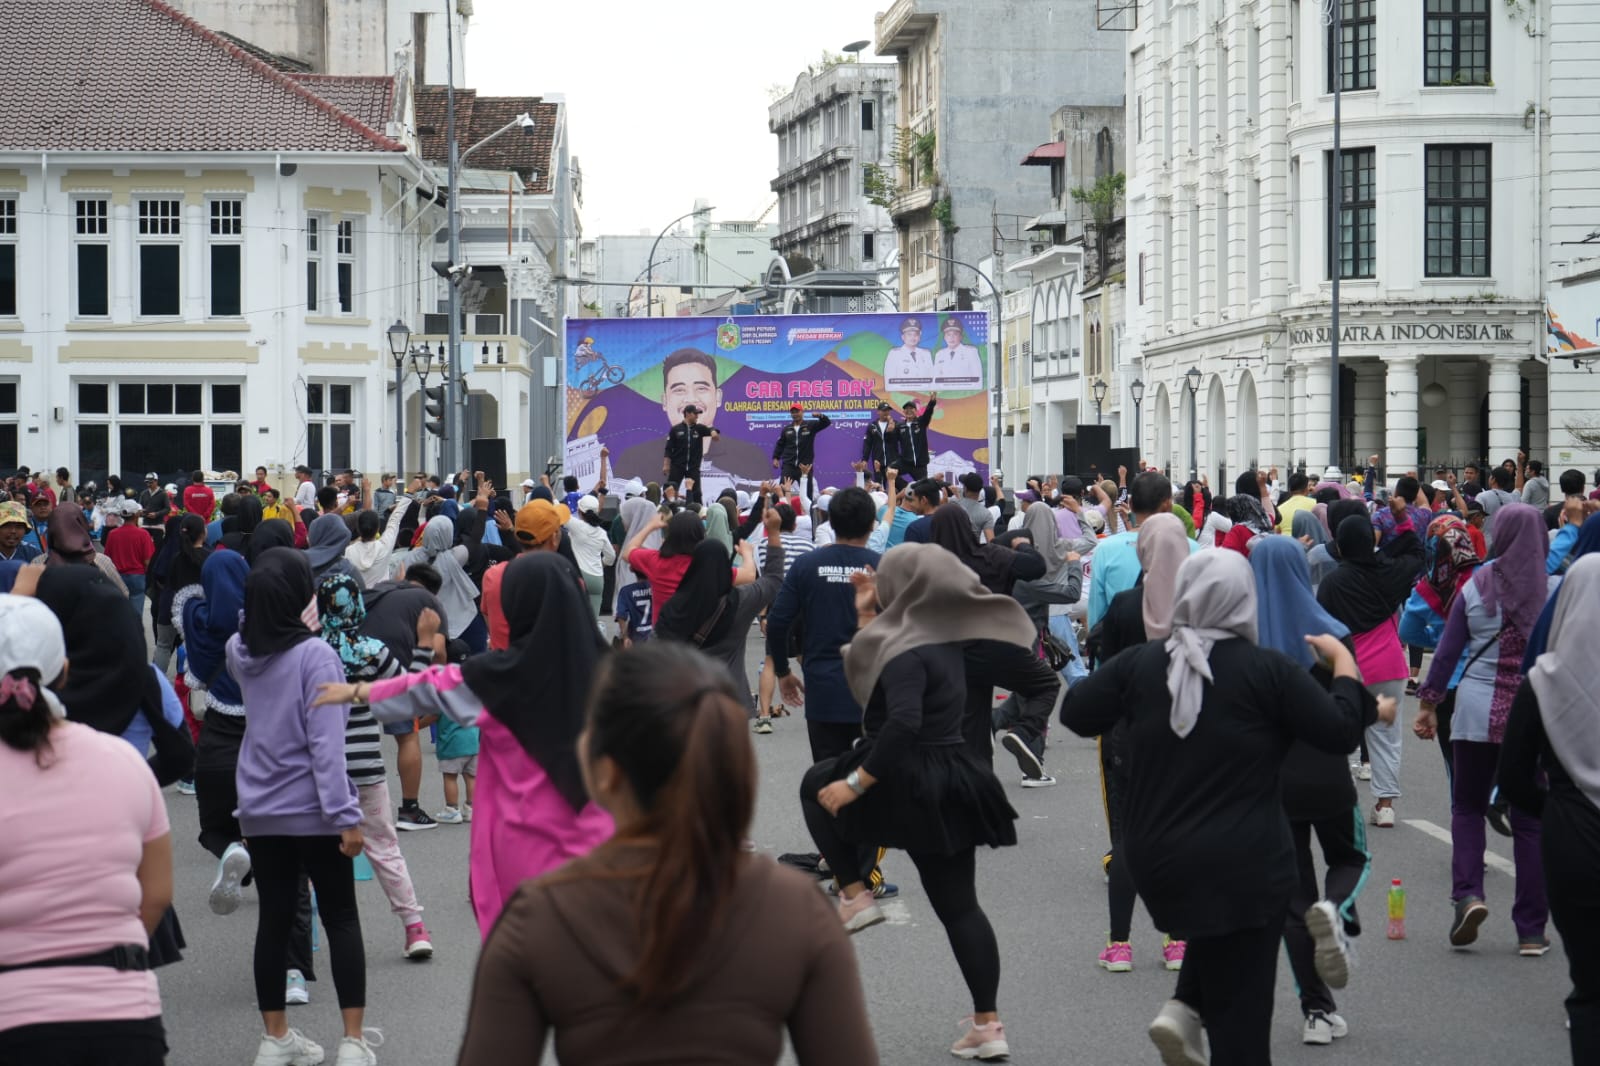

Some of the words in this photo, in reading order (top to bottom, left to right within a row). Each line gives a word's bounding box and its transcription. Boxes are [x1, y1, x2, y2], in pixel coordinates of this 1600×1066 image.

[1316, 326, 1385, 342] SUATRA
[1392, 324, 1490, 340] INDONESIA
[746, 381, 782, 398] CAR
[788, 380, 832, 398] FREE
[838, 380, 874, 396] DAY
[724, 401, 762, 412] OLAHRAGA
[844, 400, 862, 410] KOTA
[818, 566, 843, 574] DINAS
[636, 600, 650, 624] 7
